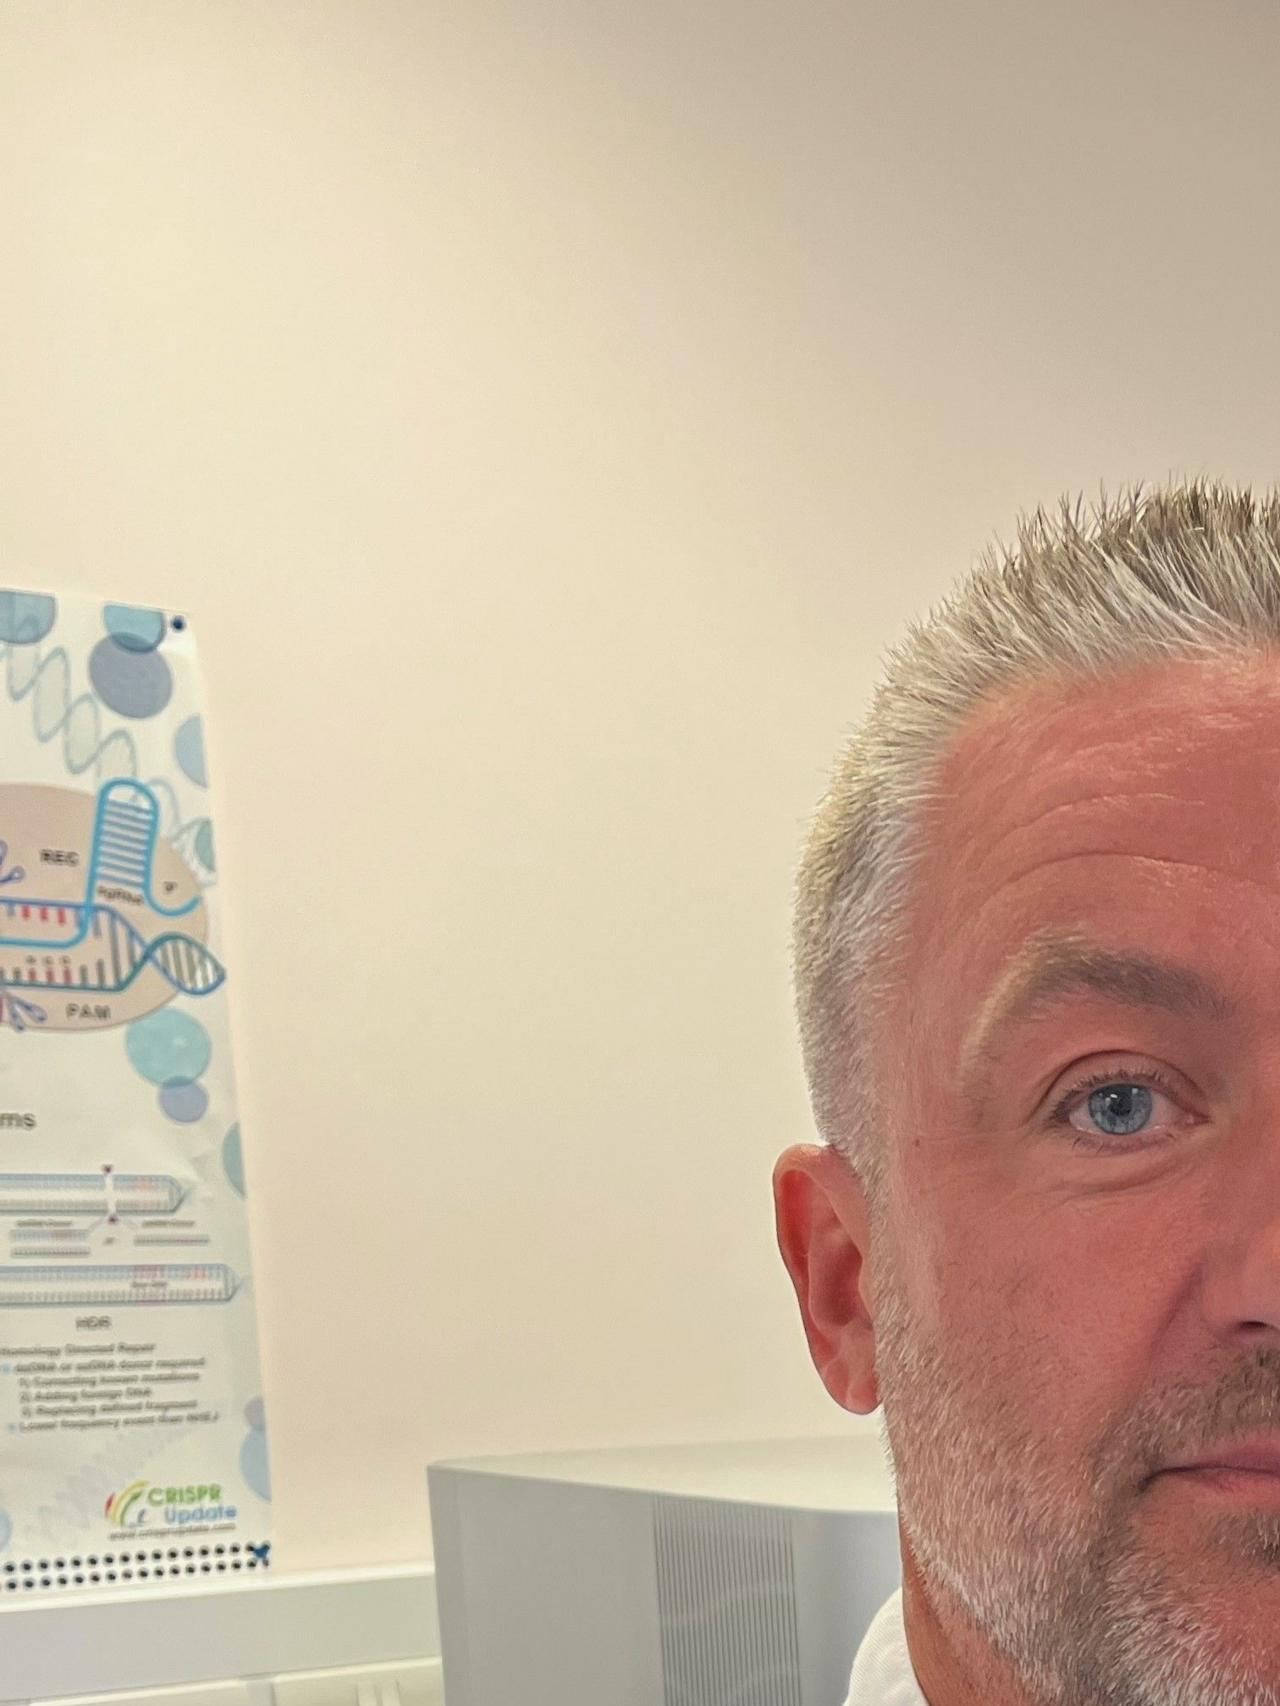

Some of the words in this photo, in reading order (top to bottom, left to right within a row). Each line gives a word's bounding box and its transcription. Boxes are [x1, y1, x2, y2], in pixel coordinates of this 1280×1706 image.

[66, 1003, 111, 1019] PAM
[148, 1484, 222, 1507] CRISPR
[165, 1505, 238, 1525] Update
